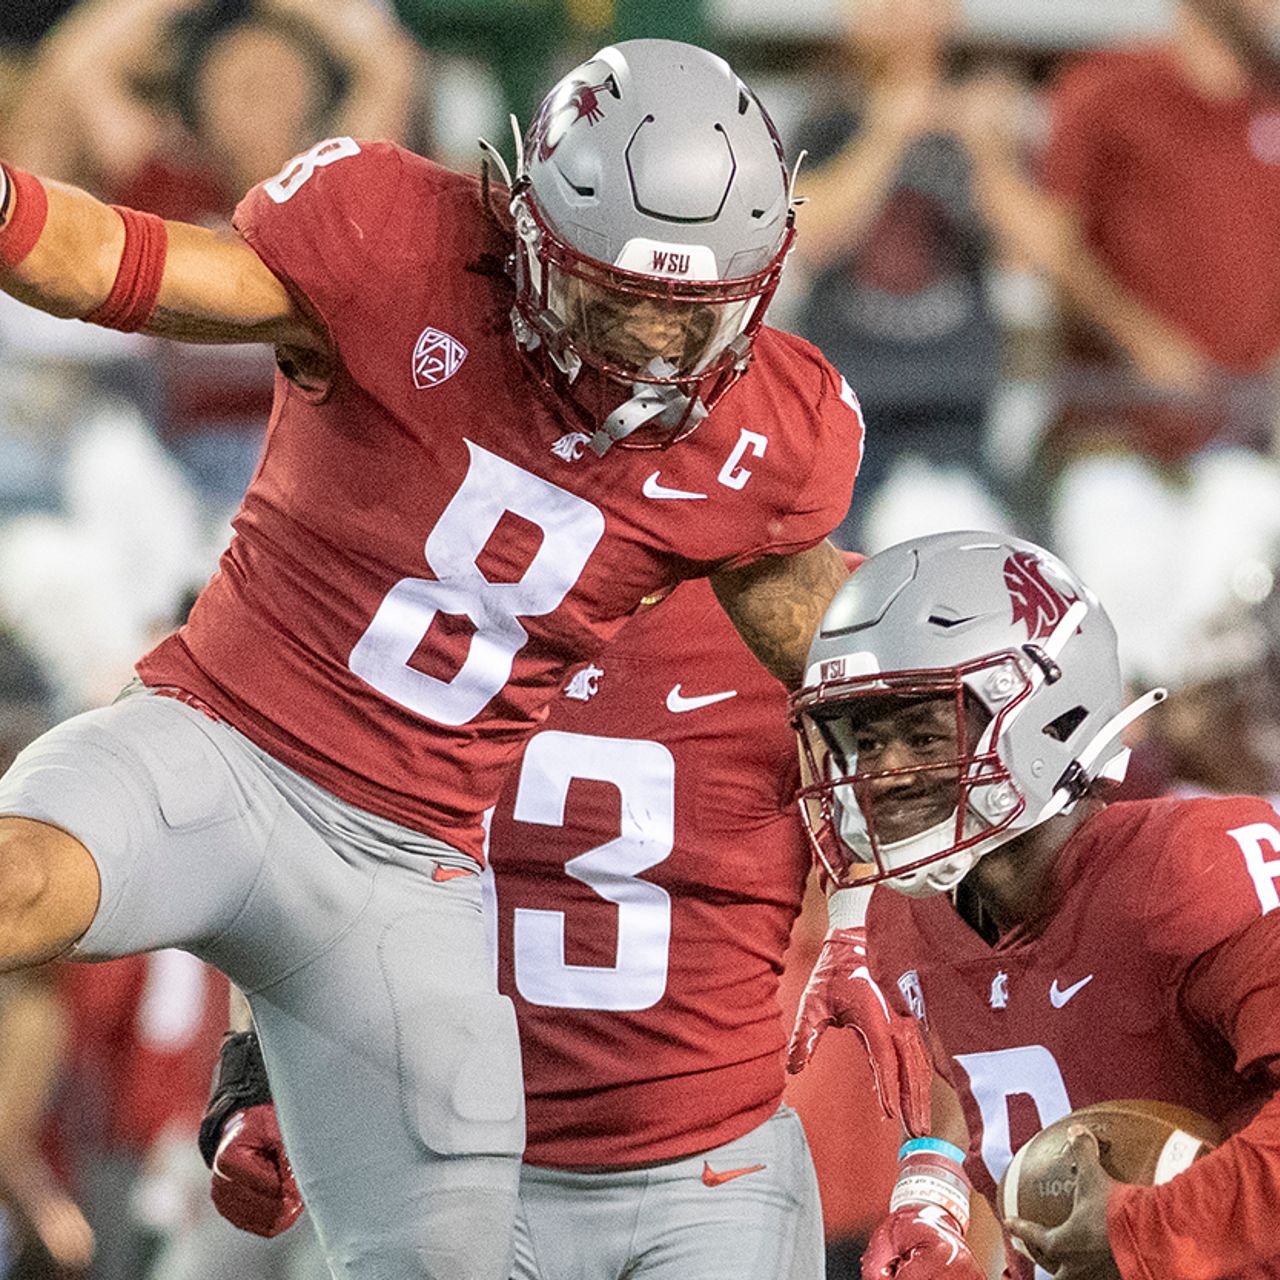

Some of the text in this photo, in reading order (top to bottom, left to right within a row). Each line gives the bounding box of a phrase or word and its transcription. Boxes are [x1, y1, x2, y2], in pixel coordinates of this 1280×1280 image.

[263, 136, 361, 204] 8
[652, 250, 690, 274] WSU
[416, 332, 465, 377] PAC
[416, 355, 445, 382] 12
[718, 428, 768, 490] C
[349, 437, 605, 726] 8
